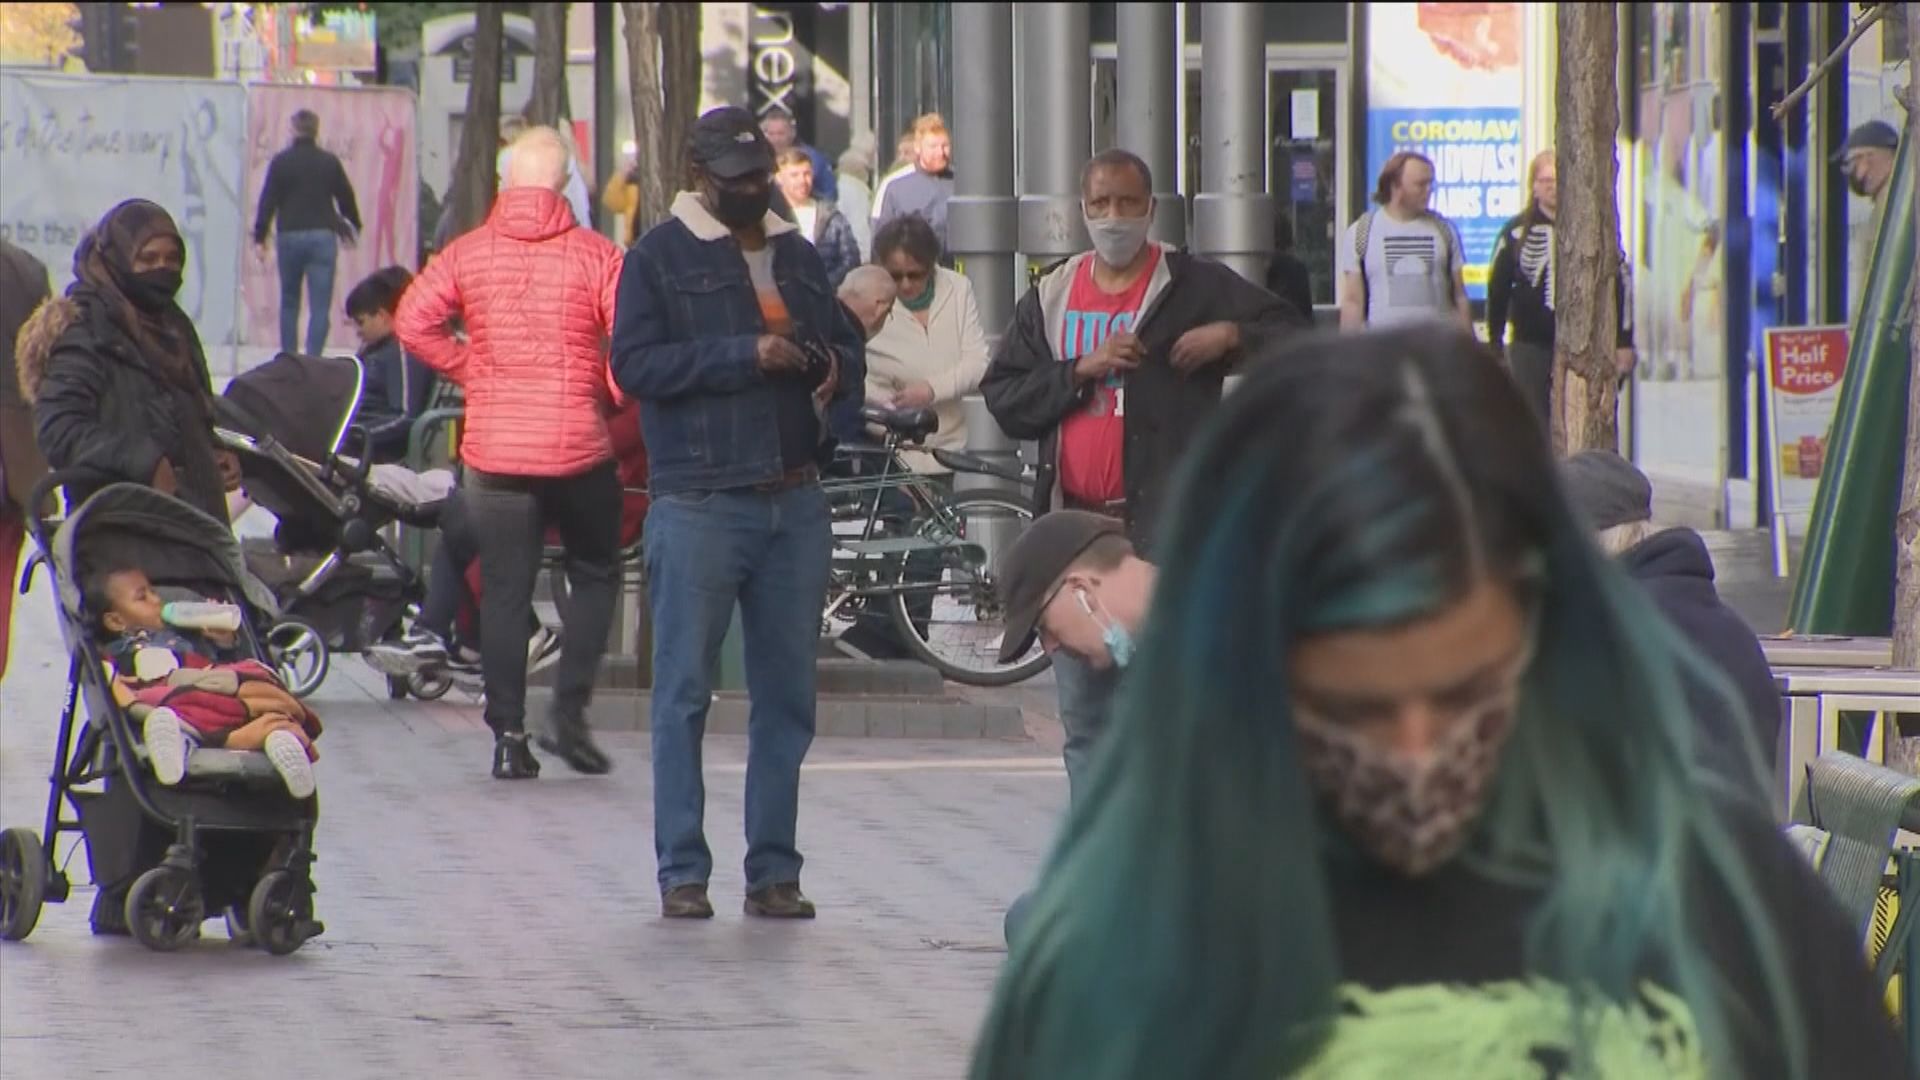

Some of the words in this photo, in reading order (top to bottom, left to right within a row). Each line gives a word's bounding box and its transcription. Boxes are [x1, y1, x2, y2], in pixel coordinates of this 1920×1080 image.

[754, 9, 795, 117] nex
[1780, 343, 1829, 365] Half
[1782, 366, 1834, 385] Price
